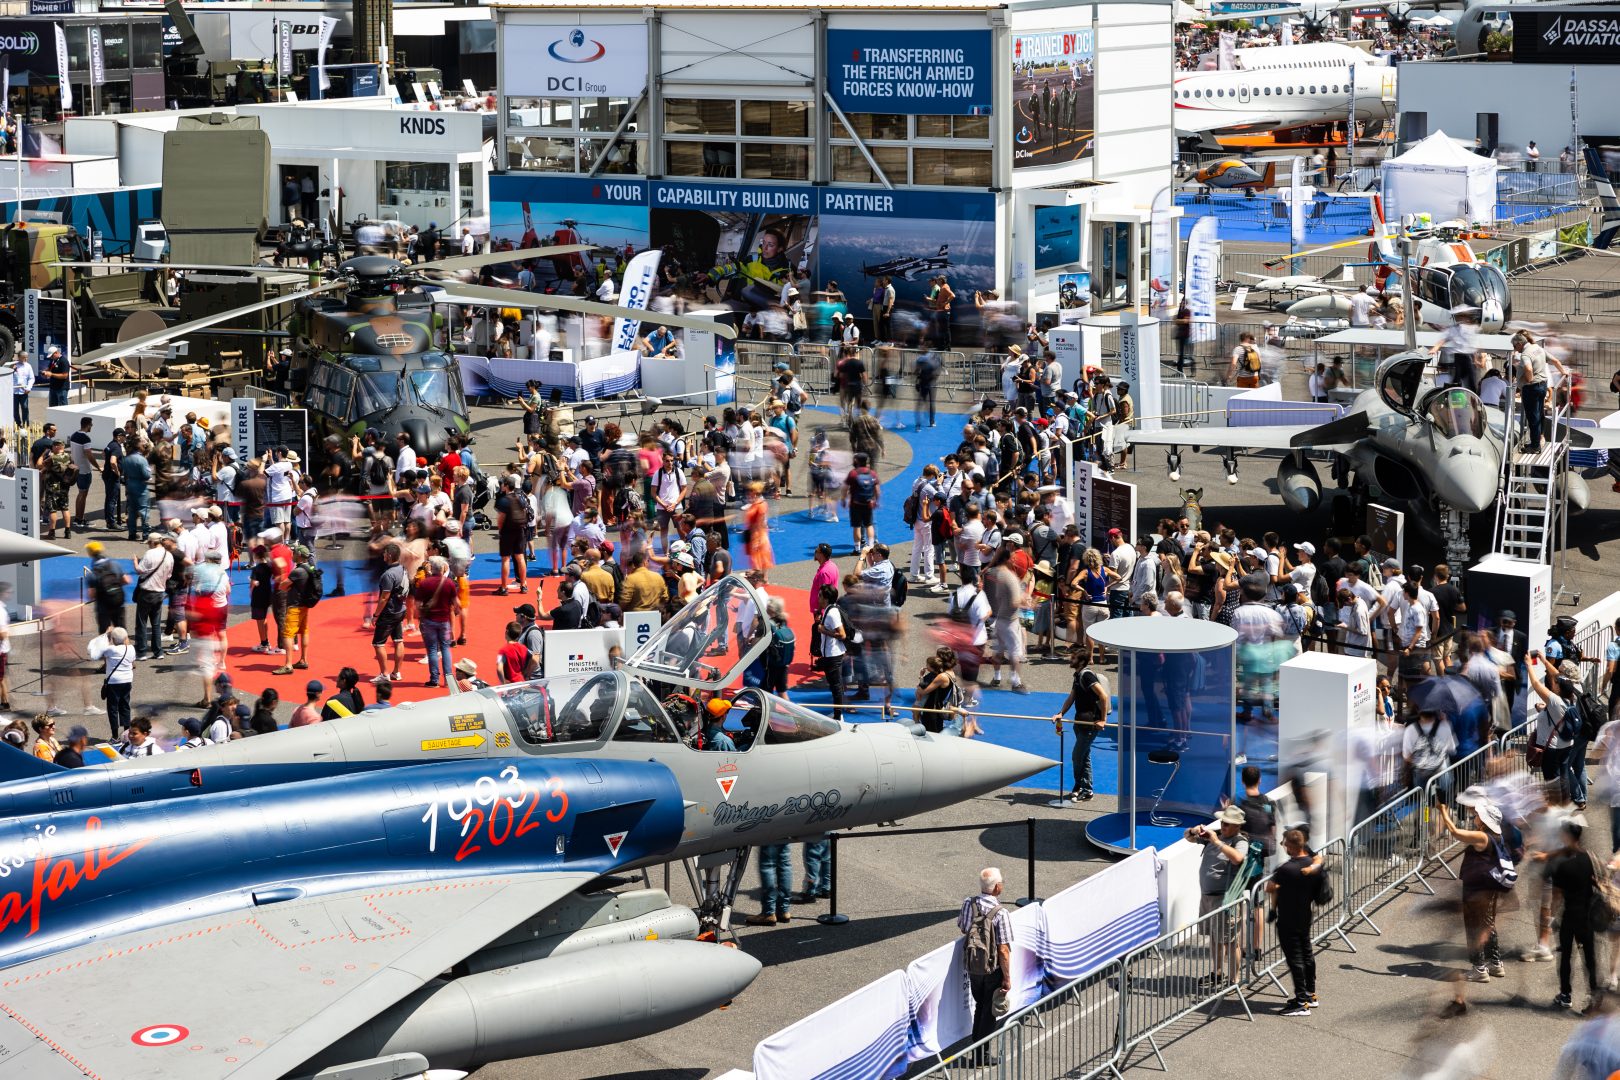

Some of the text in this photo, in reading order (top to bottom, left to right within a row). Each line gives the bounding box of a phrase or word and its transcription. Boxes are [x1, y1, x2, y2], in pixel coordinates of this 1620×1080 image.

[32, 4, 59, 12] DAHER
[291, 24, 320, 35] BD
[1564, 20, 1620, 32] DASSA
[864, 48, 964, 63] TRANSFERRING
[842, 64, 974, 81] THE FRENCH ARMED
[547, 76, 607, 94] DCI Group
[843, 82, 974, 98] FORCES KNOW-HOW
[400, 117, 446, 135] KNDS
[604, 184, 642, 201] YOUR
[657, 187, 809, 210] CAPABILITY BUILDING
[825, 193, 894, 212] PARTNER
[238, 405, 248, 442] TERRE
[20, 477, 28, 501] F4.1
[21, 504, 28, 513] B
[1080, 494, 1087, 508] M
[427, 738, 462, 749] SAUVETAGE
[421, 765, 528, 852] 1993
[713, 789, 841, 833] Mirage 2000
[454, 776, 569, 862] 2023
